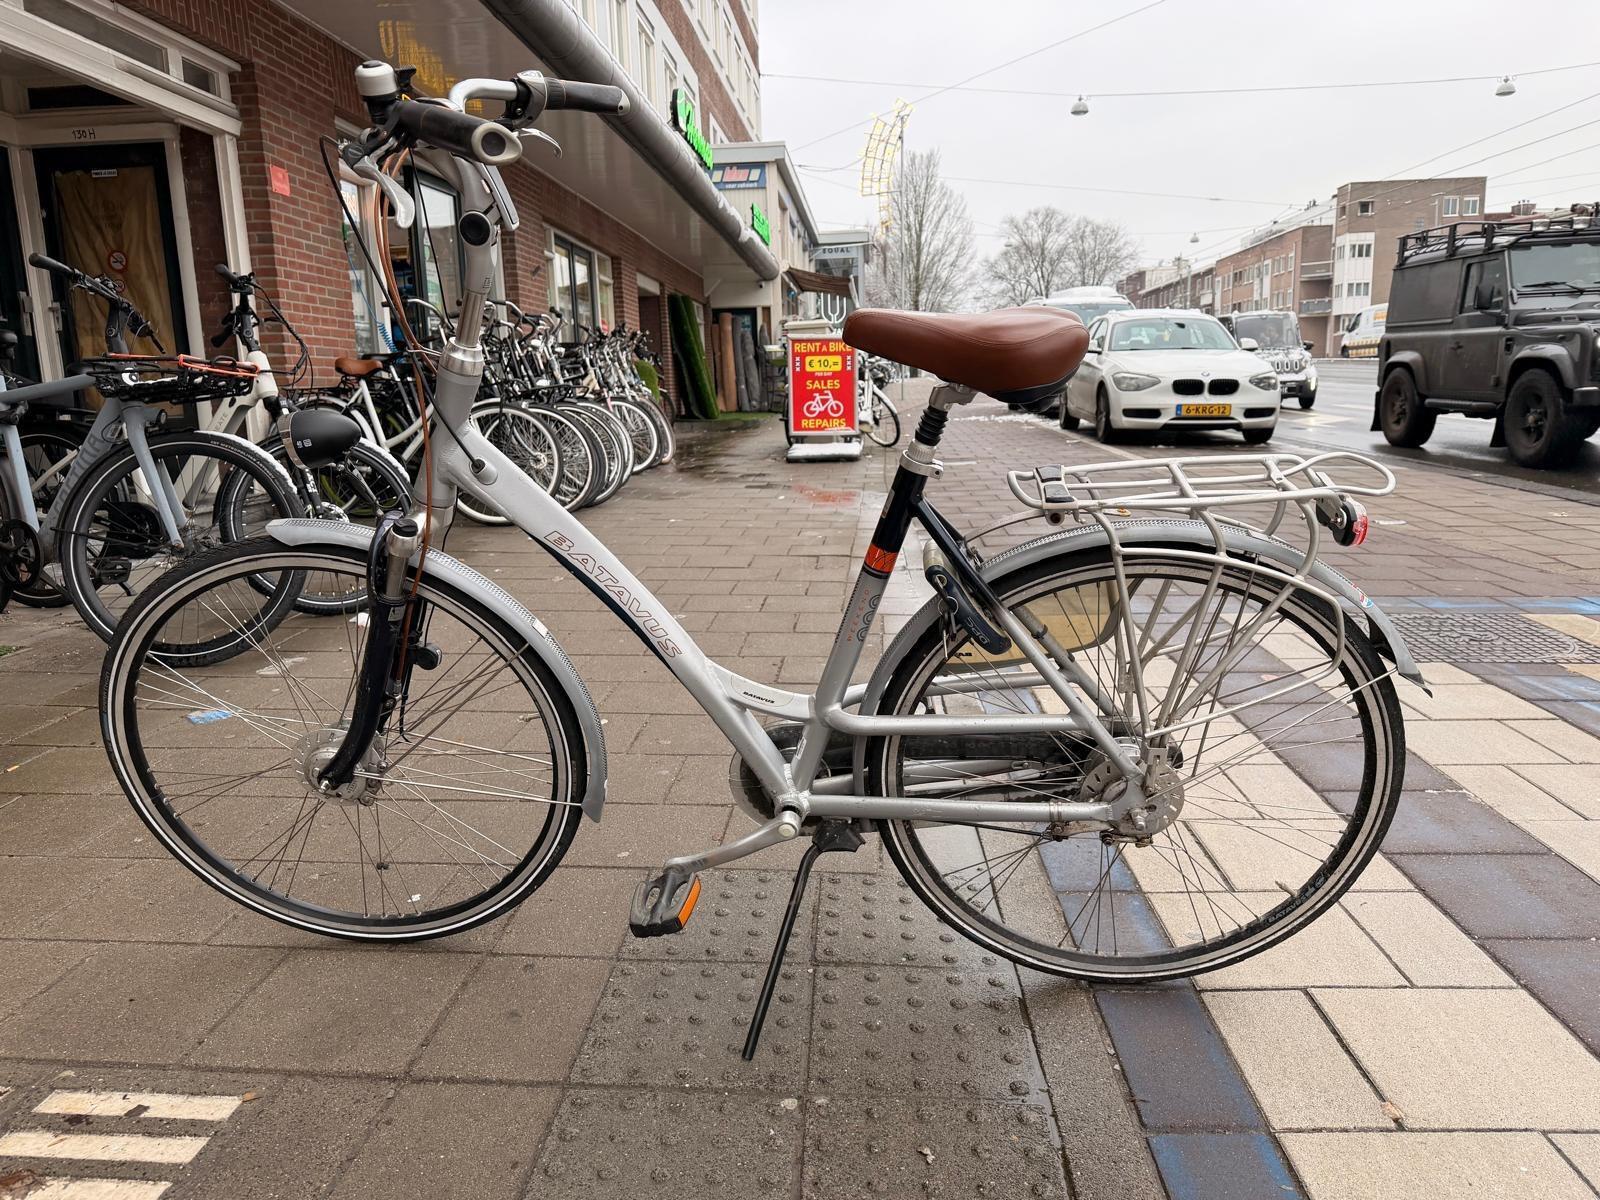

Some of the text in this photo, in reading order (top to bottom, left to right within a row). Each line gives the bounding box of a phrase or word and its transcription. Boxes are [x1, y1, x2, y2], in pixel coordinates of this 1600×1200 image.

[72, 128, 96, 140] 130 H
[794, 342, 821, 353] RENT
[829, 342, 852, 352] BIKE
[808, 359, 815, 368] €
[806, 380, 840, 390] SALES
[1185, 405, 1227, 415] 6-KRG-12
[801, 418, 846, 429] REPAIRS
[543, 530, 683, 659] BATAVUS
[743, 691, 775, 704] BATAVUS
